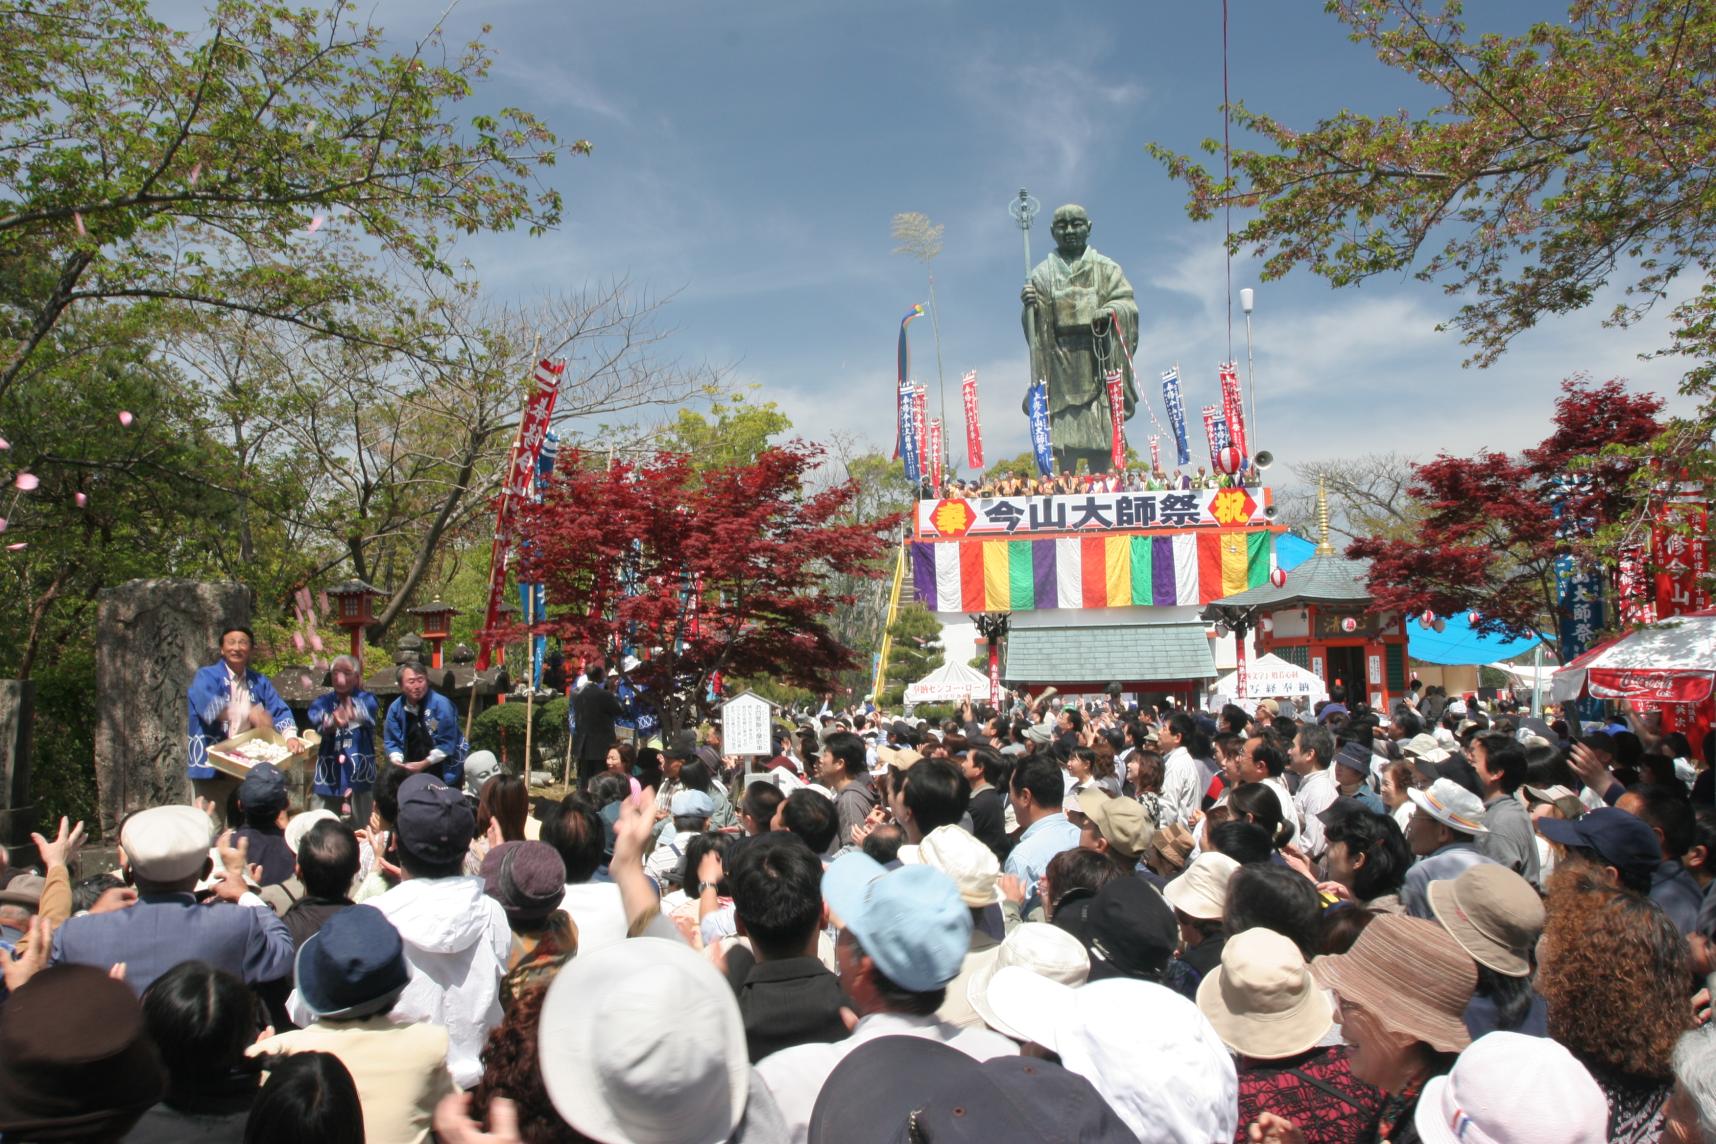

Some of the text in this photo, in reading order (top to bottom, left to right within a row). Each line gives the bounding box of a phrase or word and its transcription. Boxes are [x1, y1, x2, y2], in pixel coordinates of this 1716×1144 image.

[984, 493, 1201, 532] 今山大師祭
[1213, 491, 1248, 523] 祝
